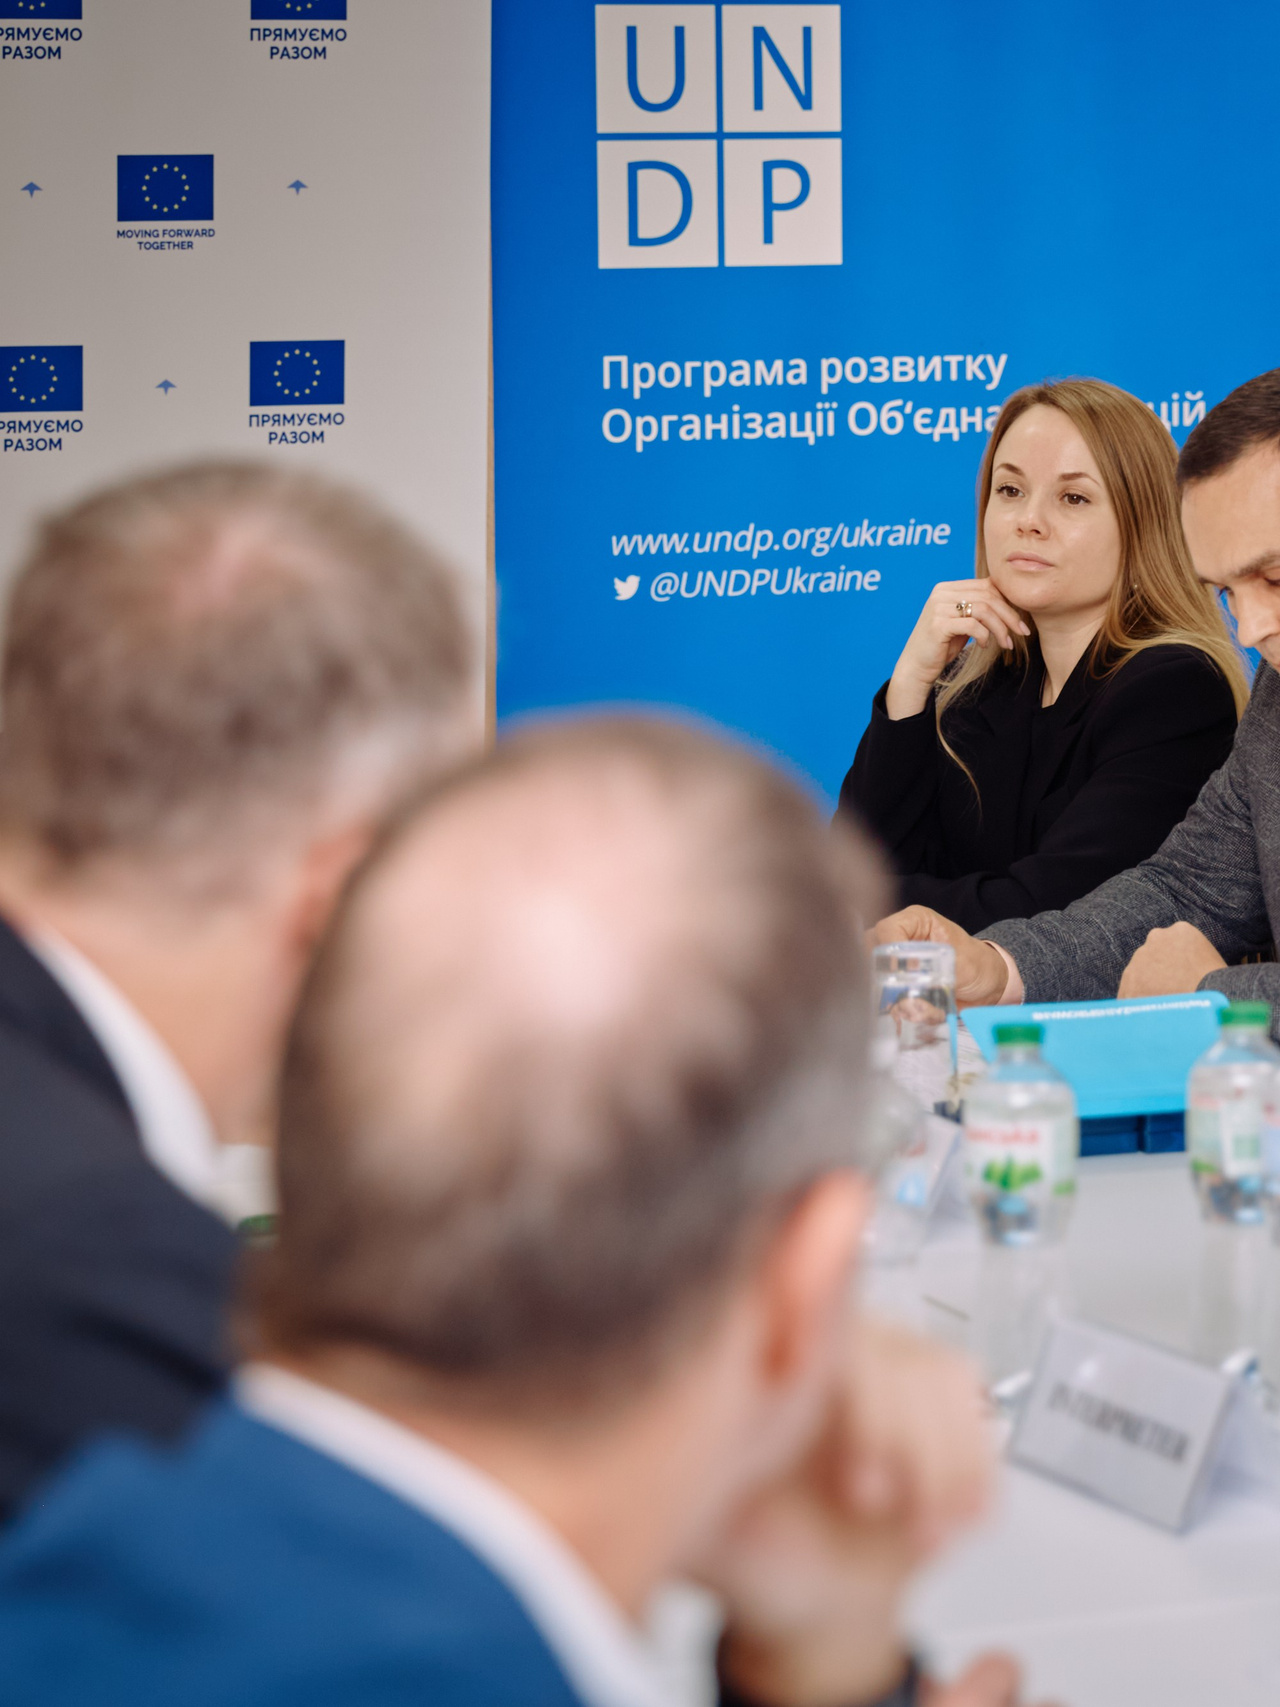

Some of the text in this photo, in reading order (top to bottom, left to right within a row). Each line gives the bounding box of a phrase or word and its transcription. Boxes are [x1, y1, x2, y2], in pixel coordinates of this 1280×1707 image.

[250, 27, 347, 42] ПРЯМУЄМО
[2, 45, 62, 60] РАЗОМ
[269, 46, 327, 60] РАЗОМ
[116, 228, 216, 239] MOVING FORWARD
[137, 240, 194, 251] TOGETHER
[602, 353, 1008, 400] Програма розвитку
[248, 412, 345, 428] ПРЯМУЄМО
[602, 401, 838, 453] Організації
[3, 437, 62, 452] РАЗОМ
[268, 430, 325, 445] РАЗОМ
[611, 518, 951, 560] www.undp.org/ukraine
[650, 565, 882, 602] @UNDPUkraine
